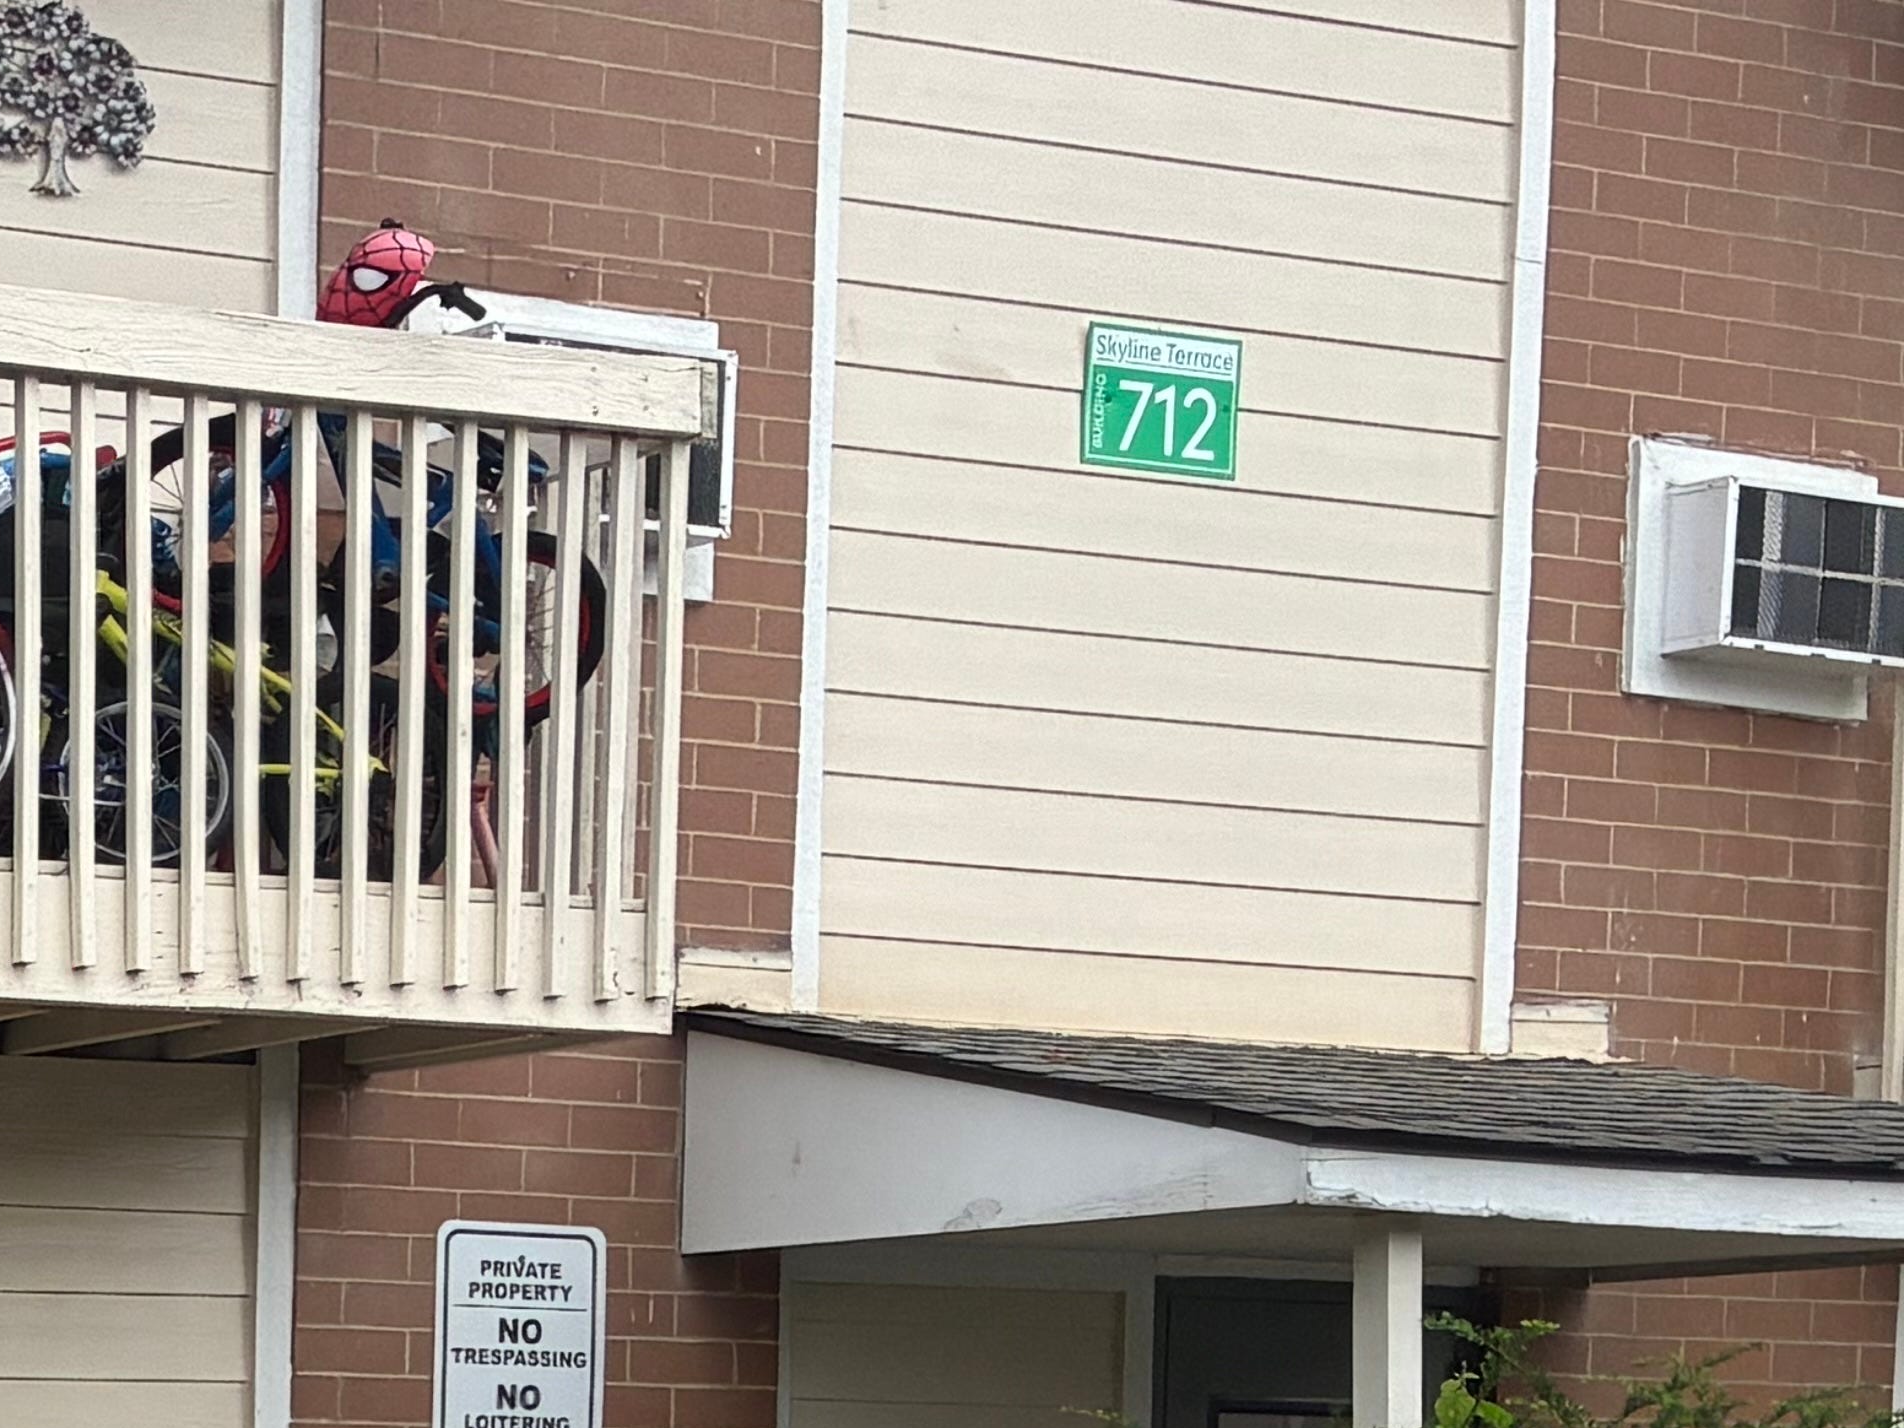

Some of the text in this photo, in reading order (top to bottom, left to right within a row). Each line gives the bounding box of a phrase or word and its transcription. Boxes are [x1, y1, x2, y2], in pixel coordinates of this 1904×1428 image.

[1096, 334, 1234, 371] Skyline Terrace
[1118, 379, 1217, 462] 712
[480, 1259, 563, 1280] PRIVATE
[468, 1282, 573, 1303] PROPERTY
[498, 1318, 543, 1344] NO
[450, 1347, 587, 1369] TRESPASSING
[496, 1384, 542, 1411] NO
